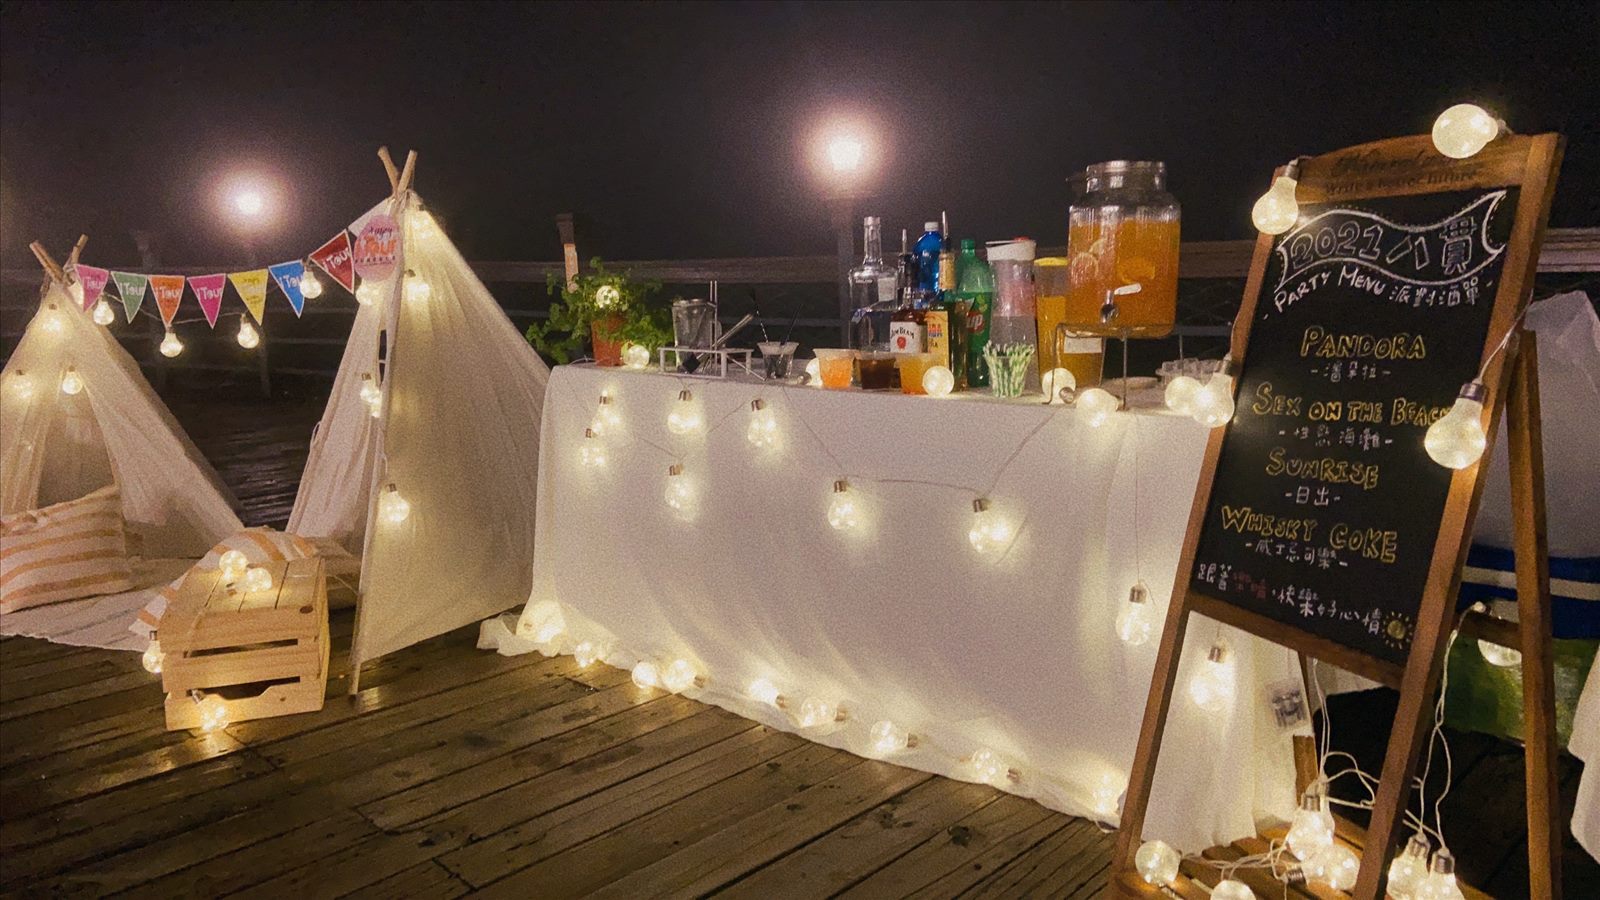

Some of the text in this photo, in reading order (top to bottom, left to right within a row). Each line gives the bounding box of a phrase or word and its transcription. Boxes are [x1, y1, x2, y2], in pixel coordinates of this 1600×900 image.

[1301, 325, 1426, 360] PANDORA
[1308, 401, 1342, 420] ON
[1347, 400, 1383, 424] THE
[1329, 523, 1398, 564] COKE
